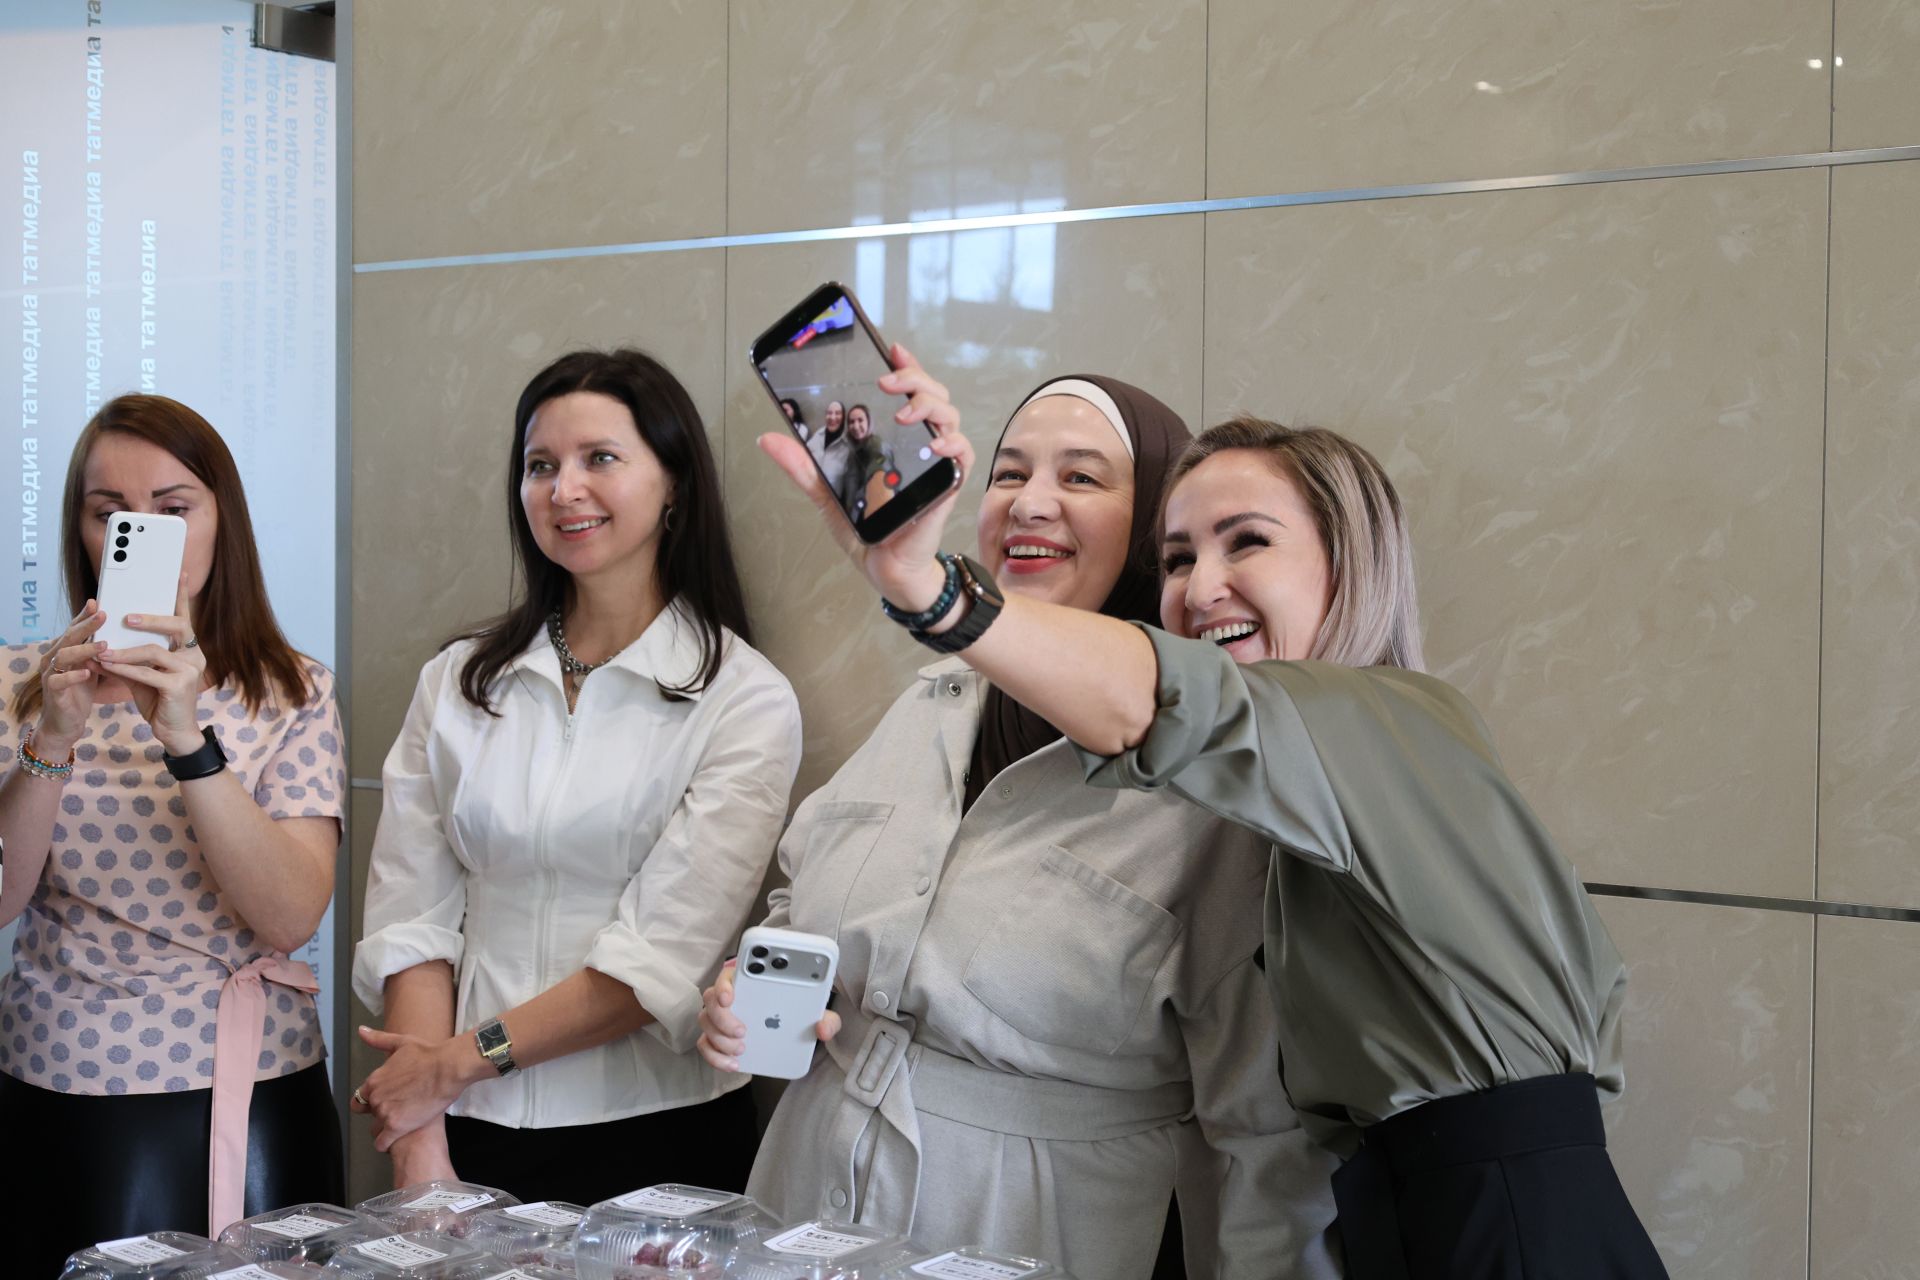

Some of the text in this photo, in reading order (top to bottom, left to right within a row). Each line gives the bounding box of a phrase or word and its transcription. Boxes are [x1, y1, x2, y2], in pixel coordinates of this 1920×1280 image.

[87, 36, 105, 163] татмедиа
[23, 150, 42, 285] татмедиа
[86, 171, 104, 298] татмедиа
[141, 219, 157, 350] татмедиа
[22, 294, 41, 429] татмедиа
[86, 307, 104, 420] атмедиа
[22, 438, 40, 571] татмедиа
